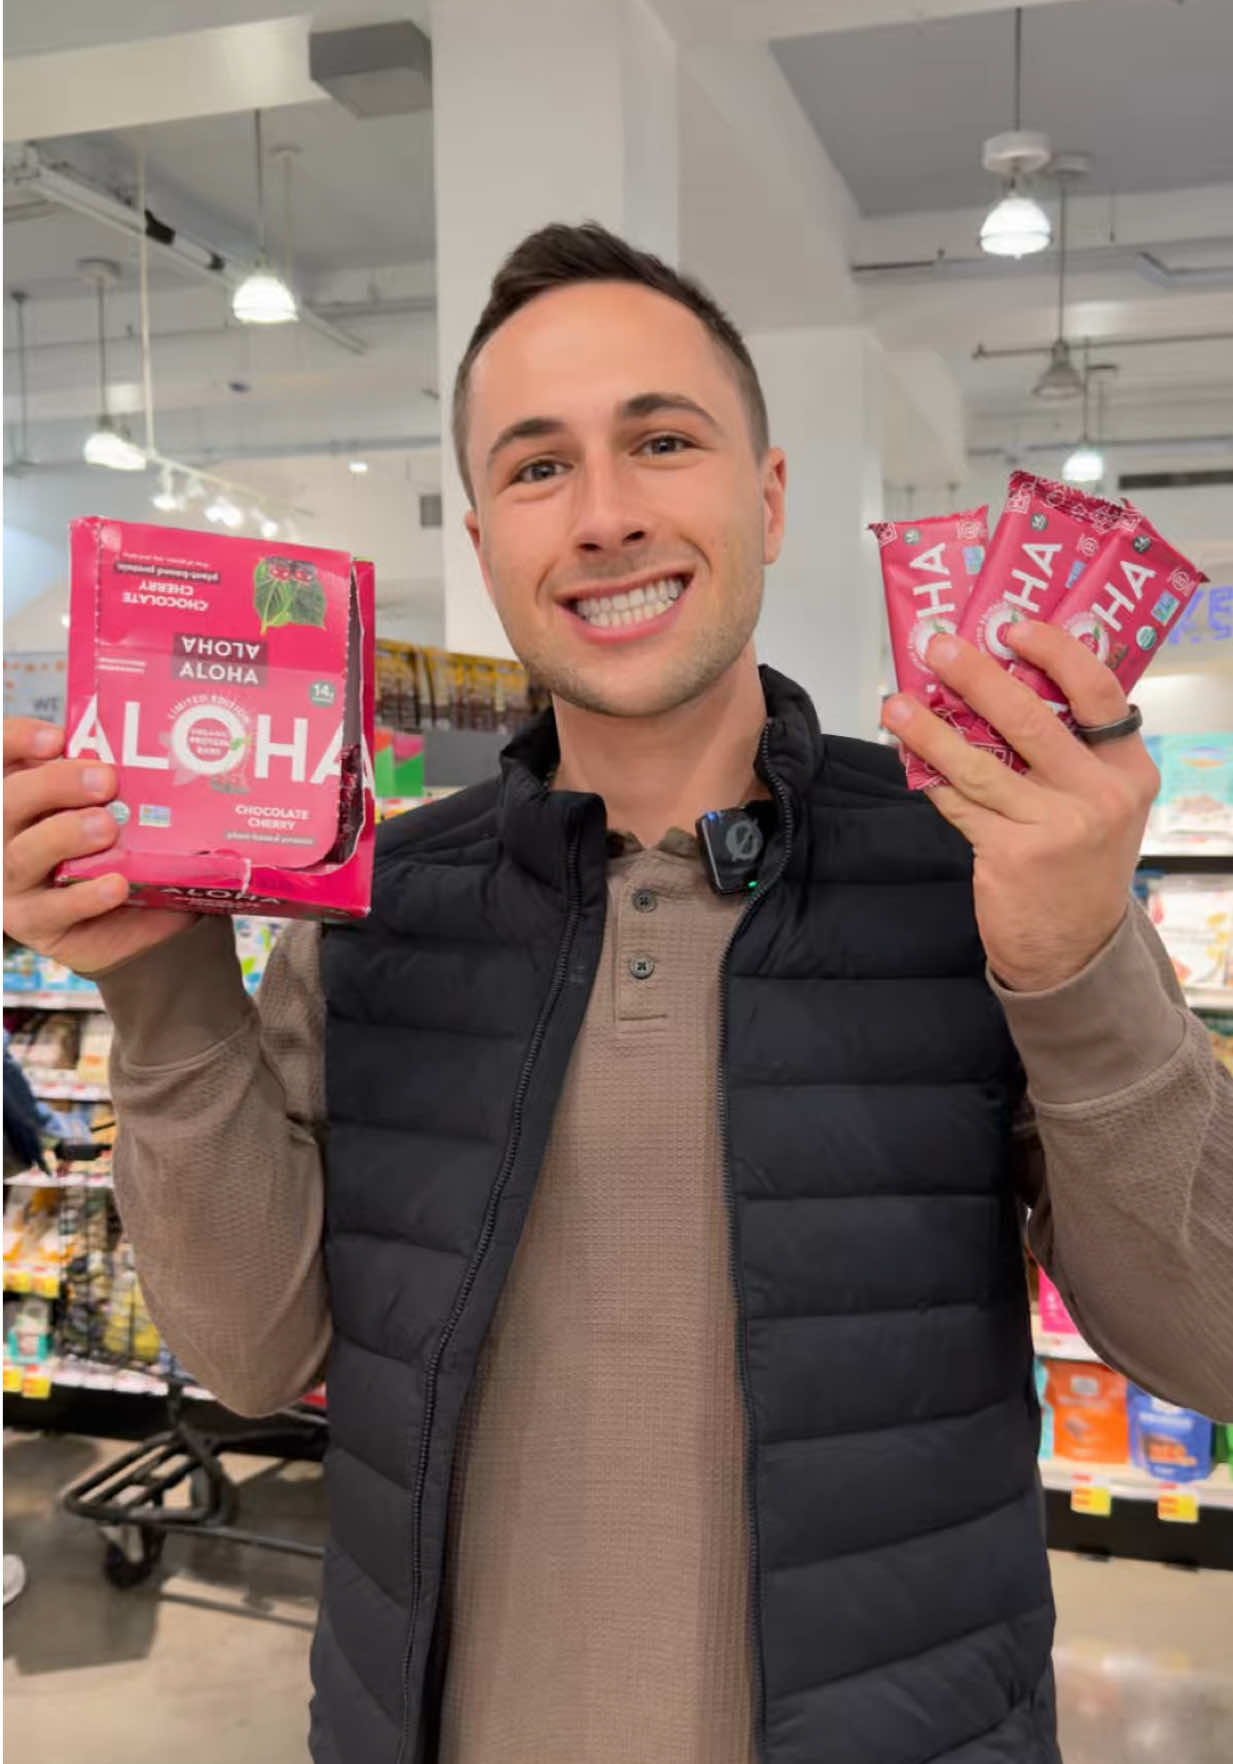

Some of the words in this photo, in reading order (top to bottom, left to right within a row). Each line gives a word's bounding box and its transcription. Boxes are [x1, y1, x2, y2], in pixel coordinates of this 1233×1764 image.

[139, 580, 194, 596] CHERRY
[122, 592, 208, 611] CHOCOLATE
[181, 636, 260, 659] ALOHA
[179, 661, 259, 685] ALOHA
[67, 693, 375, 796] ALOHA
[235, 804, 309, 821] CHOCOLATE
[248, 816, 295, 831] CHERRY
[161, 887, 280, 904] ALOHA
